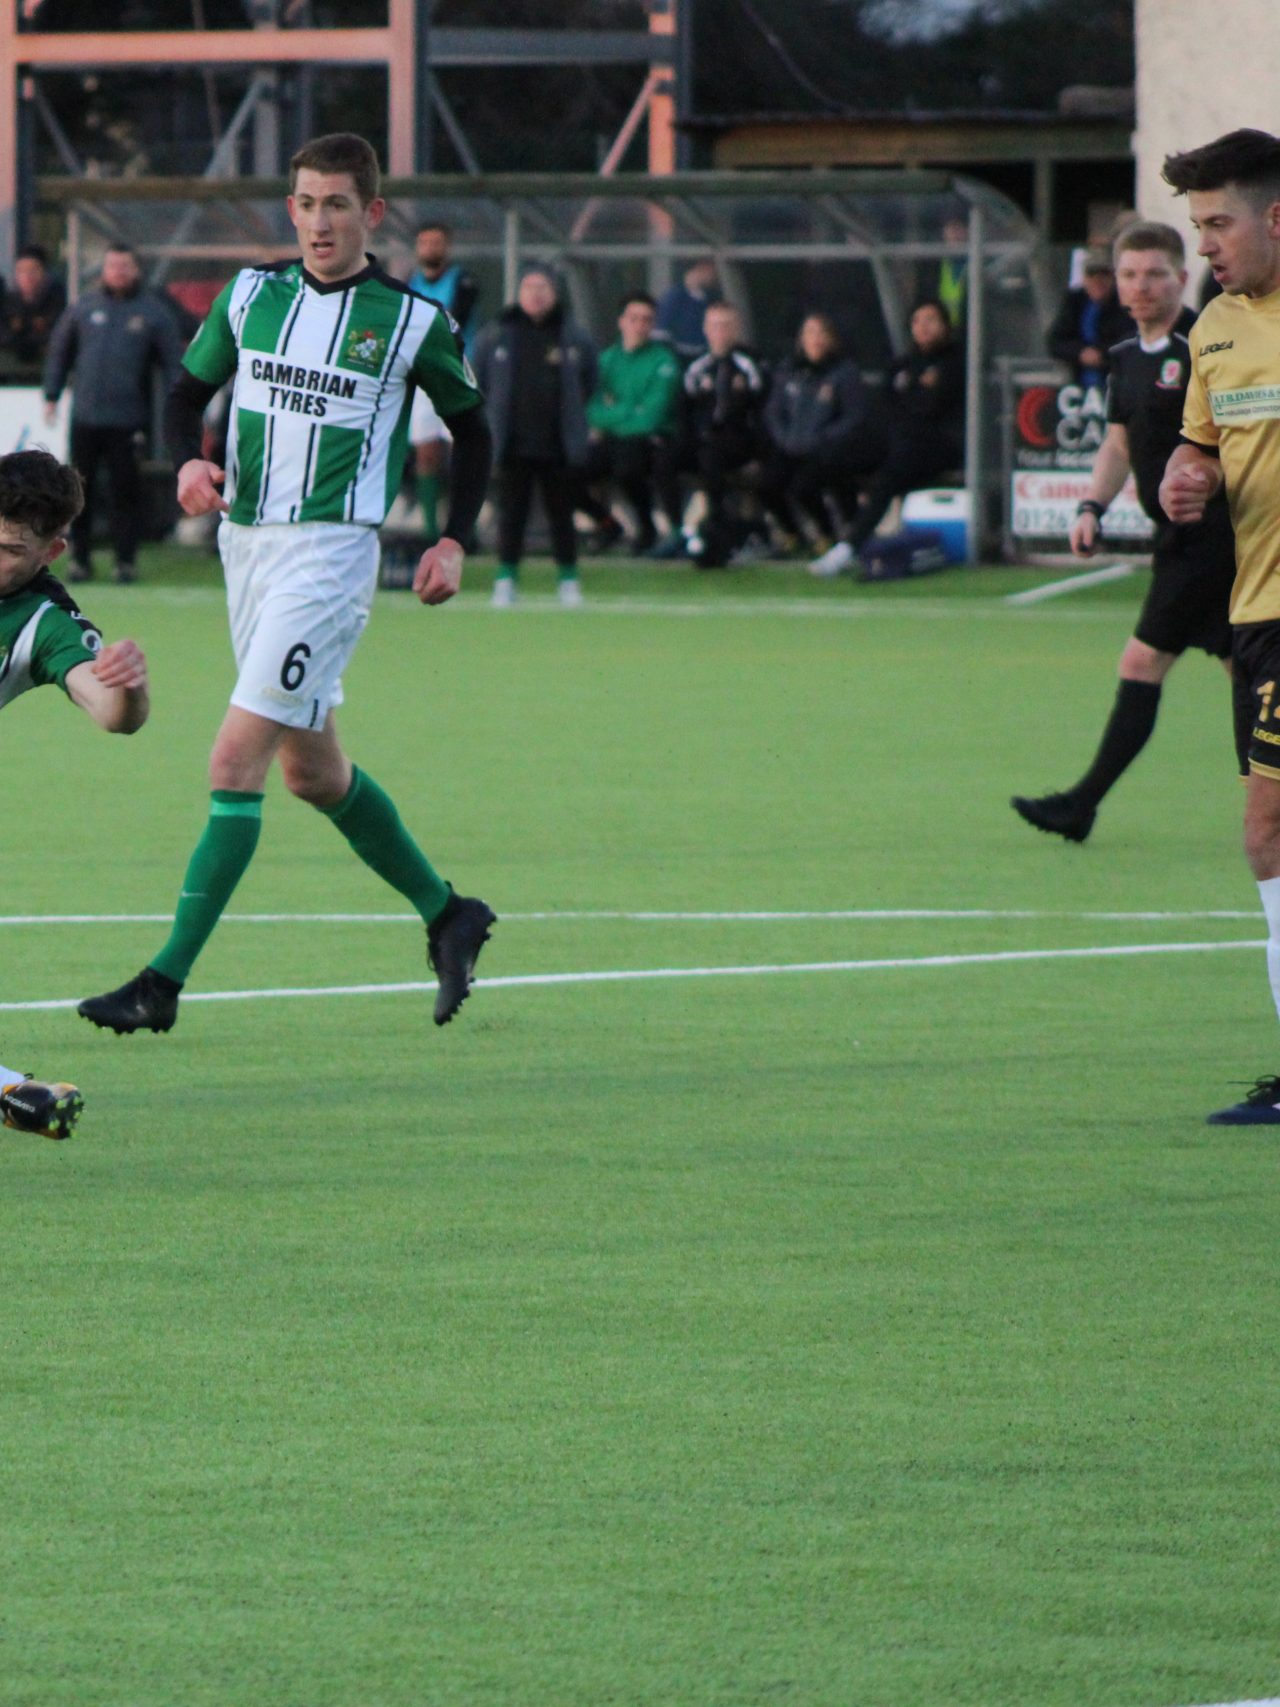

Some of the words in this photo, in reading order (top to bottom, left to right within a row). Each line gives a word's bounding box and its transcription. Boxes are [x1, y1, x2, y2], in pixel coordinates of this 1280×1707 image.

[1199, 340, 1234, 357] LEGEA
[251, 358, 357, 399] CAMBRIAN
[269, 386, 328, 417] TYRES
[1057, 384, 1105, 417] CA
[1056, 417, 1103, 449] CA
[281, 642, 312, 692] 6
[1252, 726, 1280, 746] LEGE
